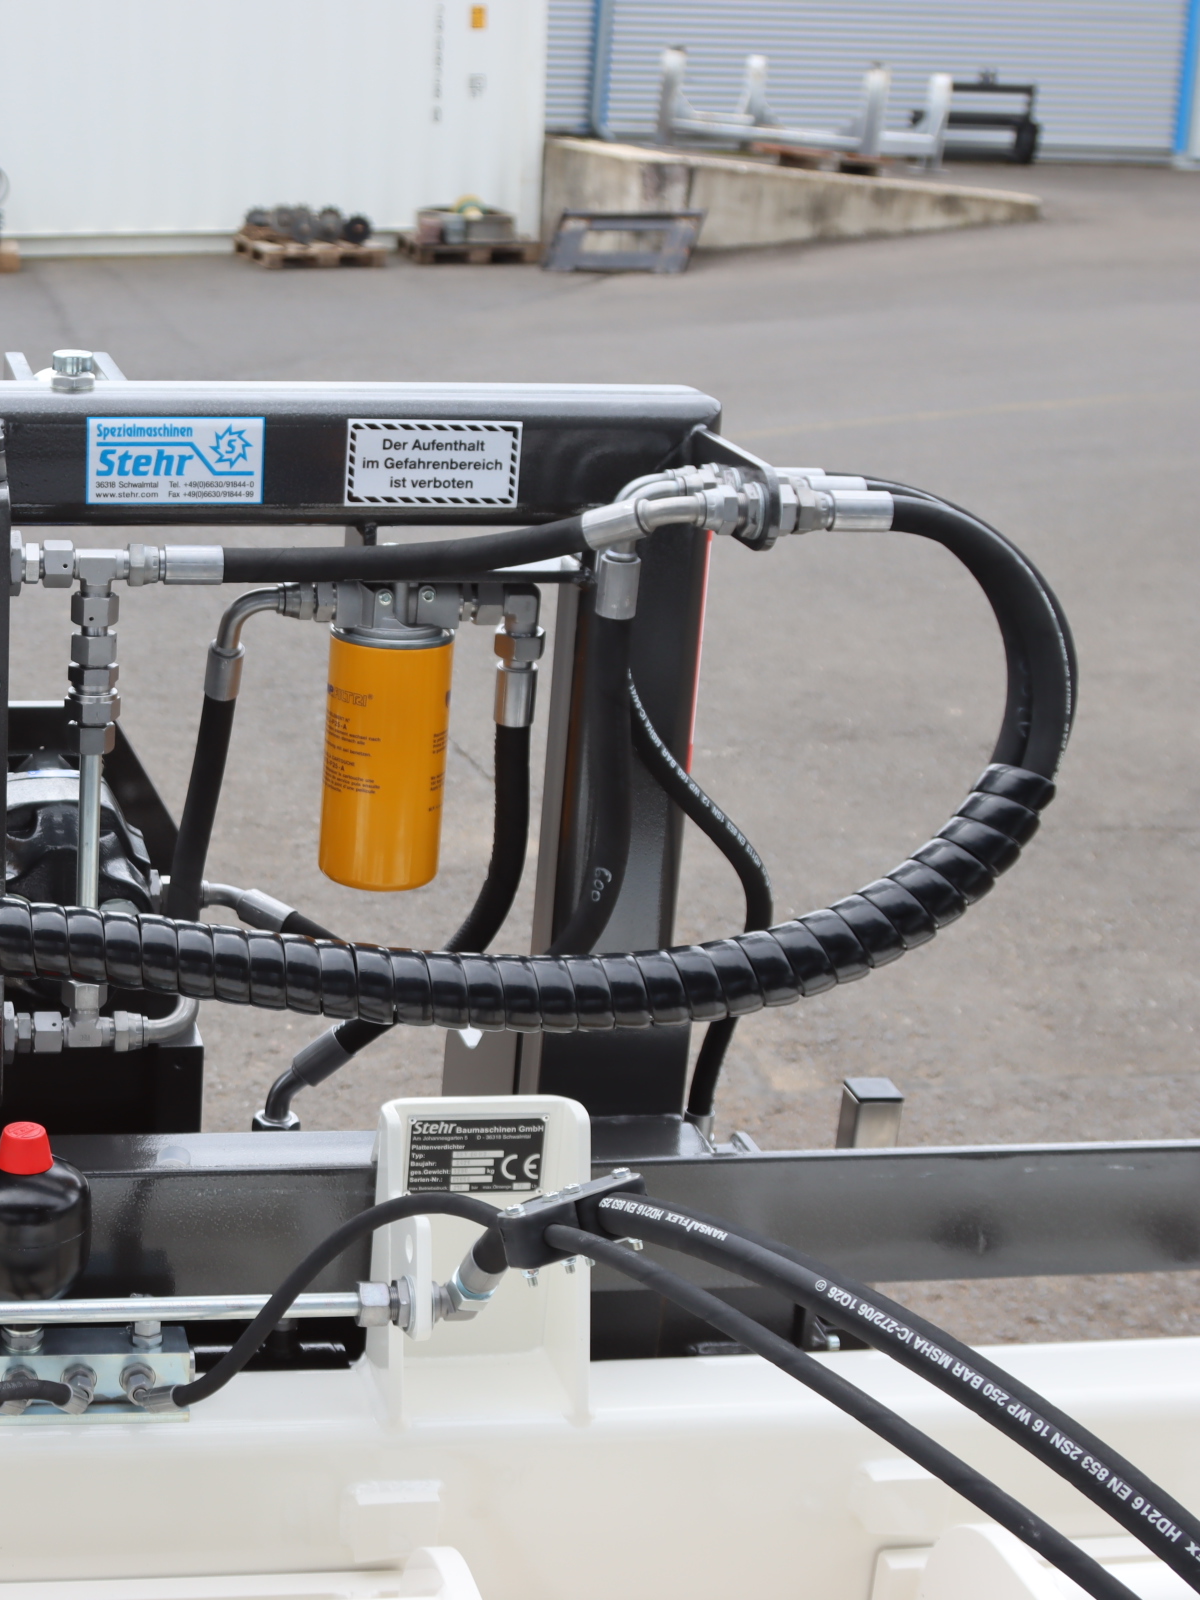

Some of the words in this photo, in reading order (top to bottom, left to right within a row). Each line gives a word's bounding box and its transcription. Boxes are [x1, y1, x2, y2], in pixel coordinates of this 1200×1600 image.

[96, 423, 193, 440] Spezialmaschinen
[382, 438, 408, 452] Der
[411, 438, 485, 452] Aufenthalt
[96, 449, 194, 476] Stehr
[362, 457, 379, 470] im
[383, 457, 503, 471] Gefahrenbereich
[389, 476, 408, 489] ist
[411, 476, 474, 489] verboten
[661, 747, 677, 769] BAR
[413, 1121, 457, 1135] Stehr
[456, 1126, 517, 1134] Baumaschinen
[518, 1125, 544, 1133] GmbH
[611, 1199, 624, 1211] 853
[624, 1201, 639, 1214] EN
[636, 1204, 665, 1221] HD216
[827, 1286, 858, 1310] 1Q26
[857, 1304, 914, 1344] IC-272/06
[913, 1336, 954, 1370] MSHA
[952, 1361, 985, 1390] BAR
[982, 1383, 1011, 1407] 250
[1007, 1403, 1032, 1426] WP
[1031, 1419, 1050, 1437] 16
[1050, 1432, 1084, 1461] 2SN
[1081, 1456, 1110, 1482] 853
[1106, 1476, 1133, 1501] EN
[1131, 1496, 1183, 1543] HD216
